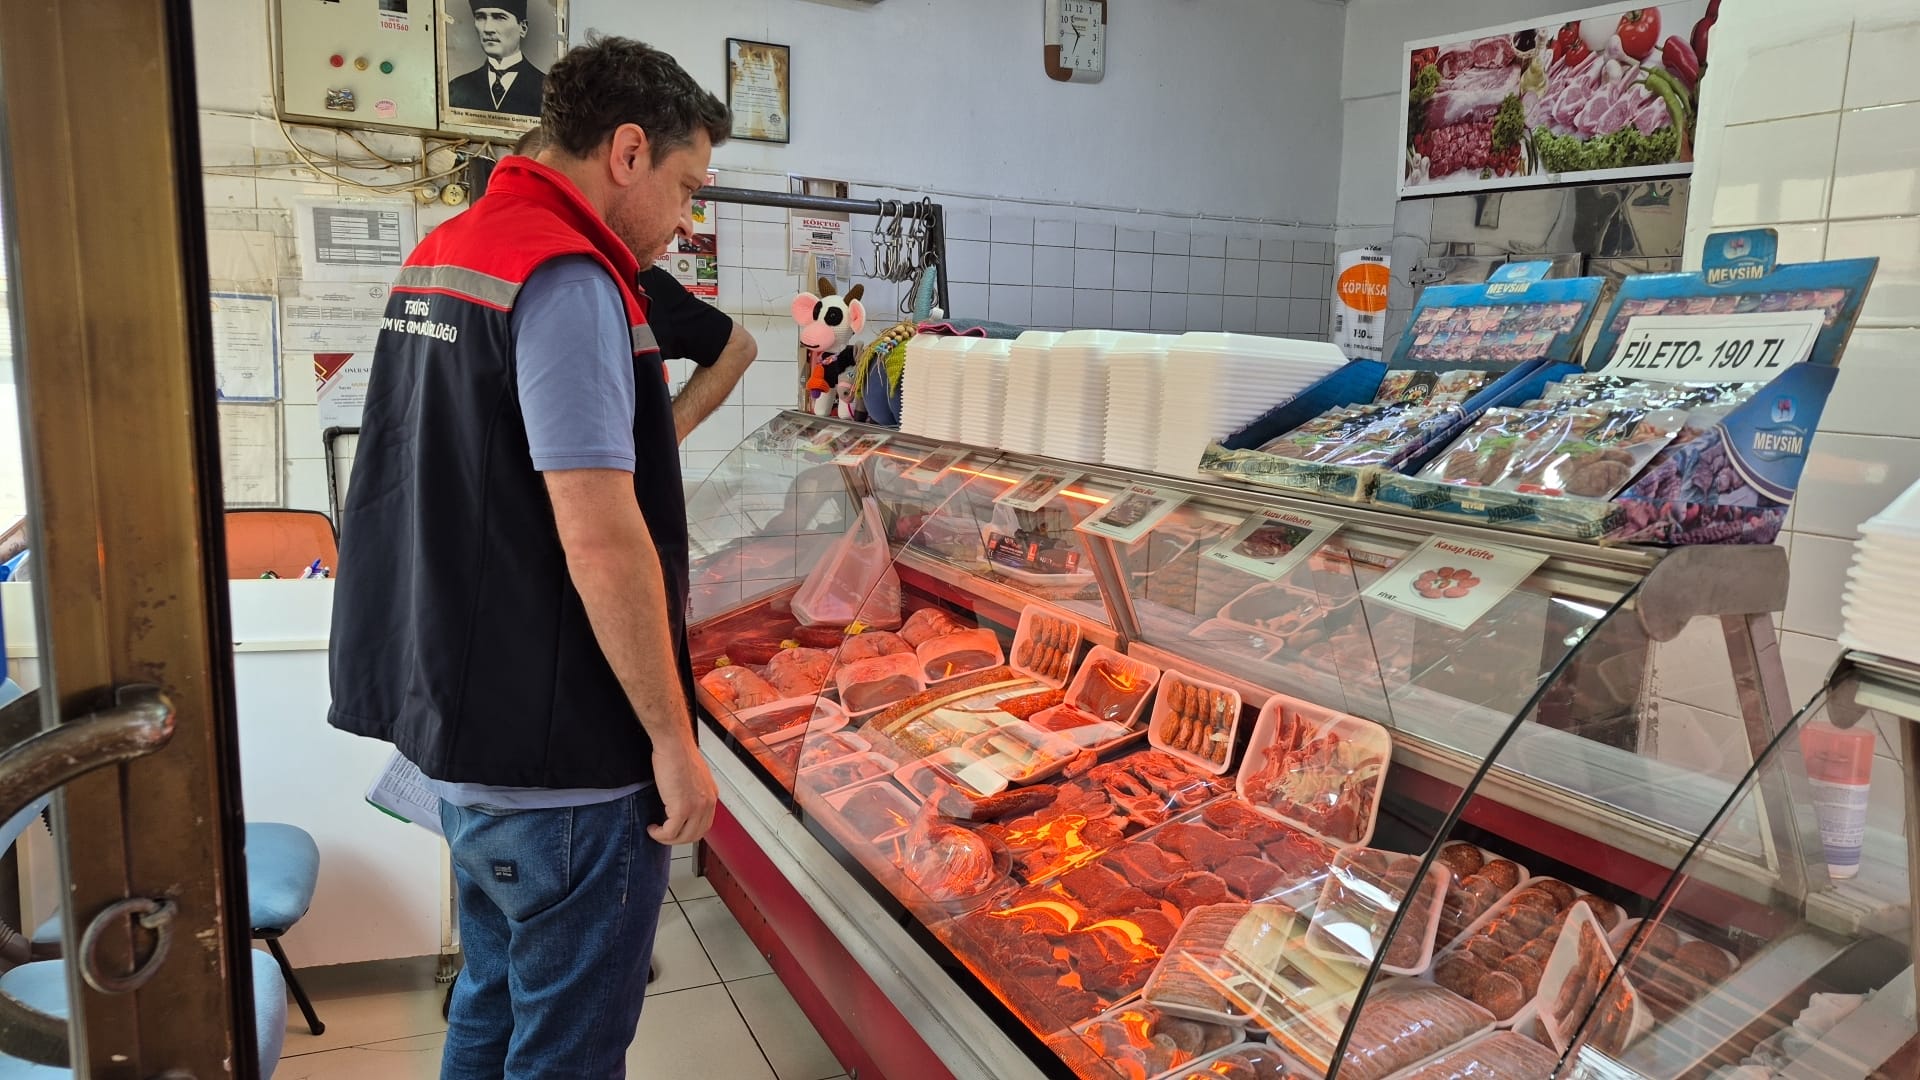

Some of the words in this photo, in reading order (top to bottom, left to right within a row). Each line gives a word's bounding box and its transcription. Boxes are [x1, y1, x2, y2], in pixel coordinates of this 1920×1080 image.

[394, 318, 406, 333] VE
[1708, 339, 1754, 369] 190
[1754, 338, 1785, 368] TL
[1434, 540, 1465, 555] Kasap
[1464, 547, 1494, 560] Köfte
